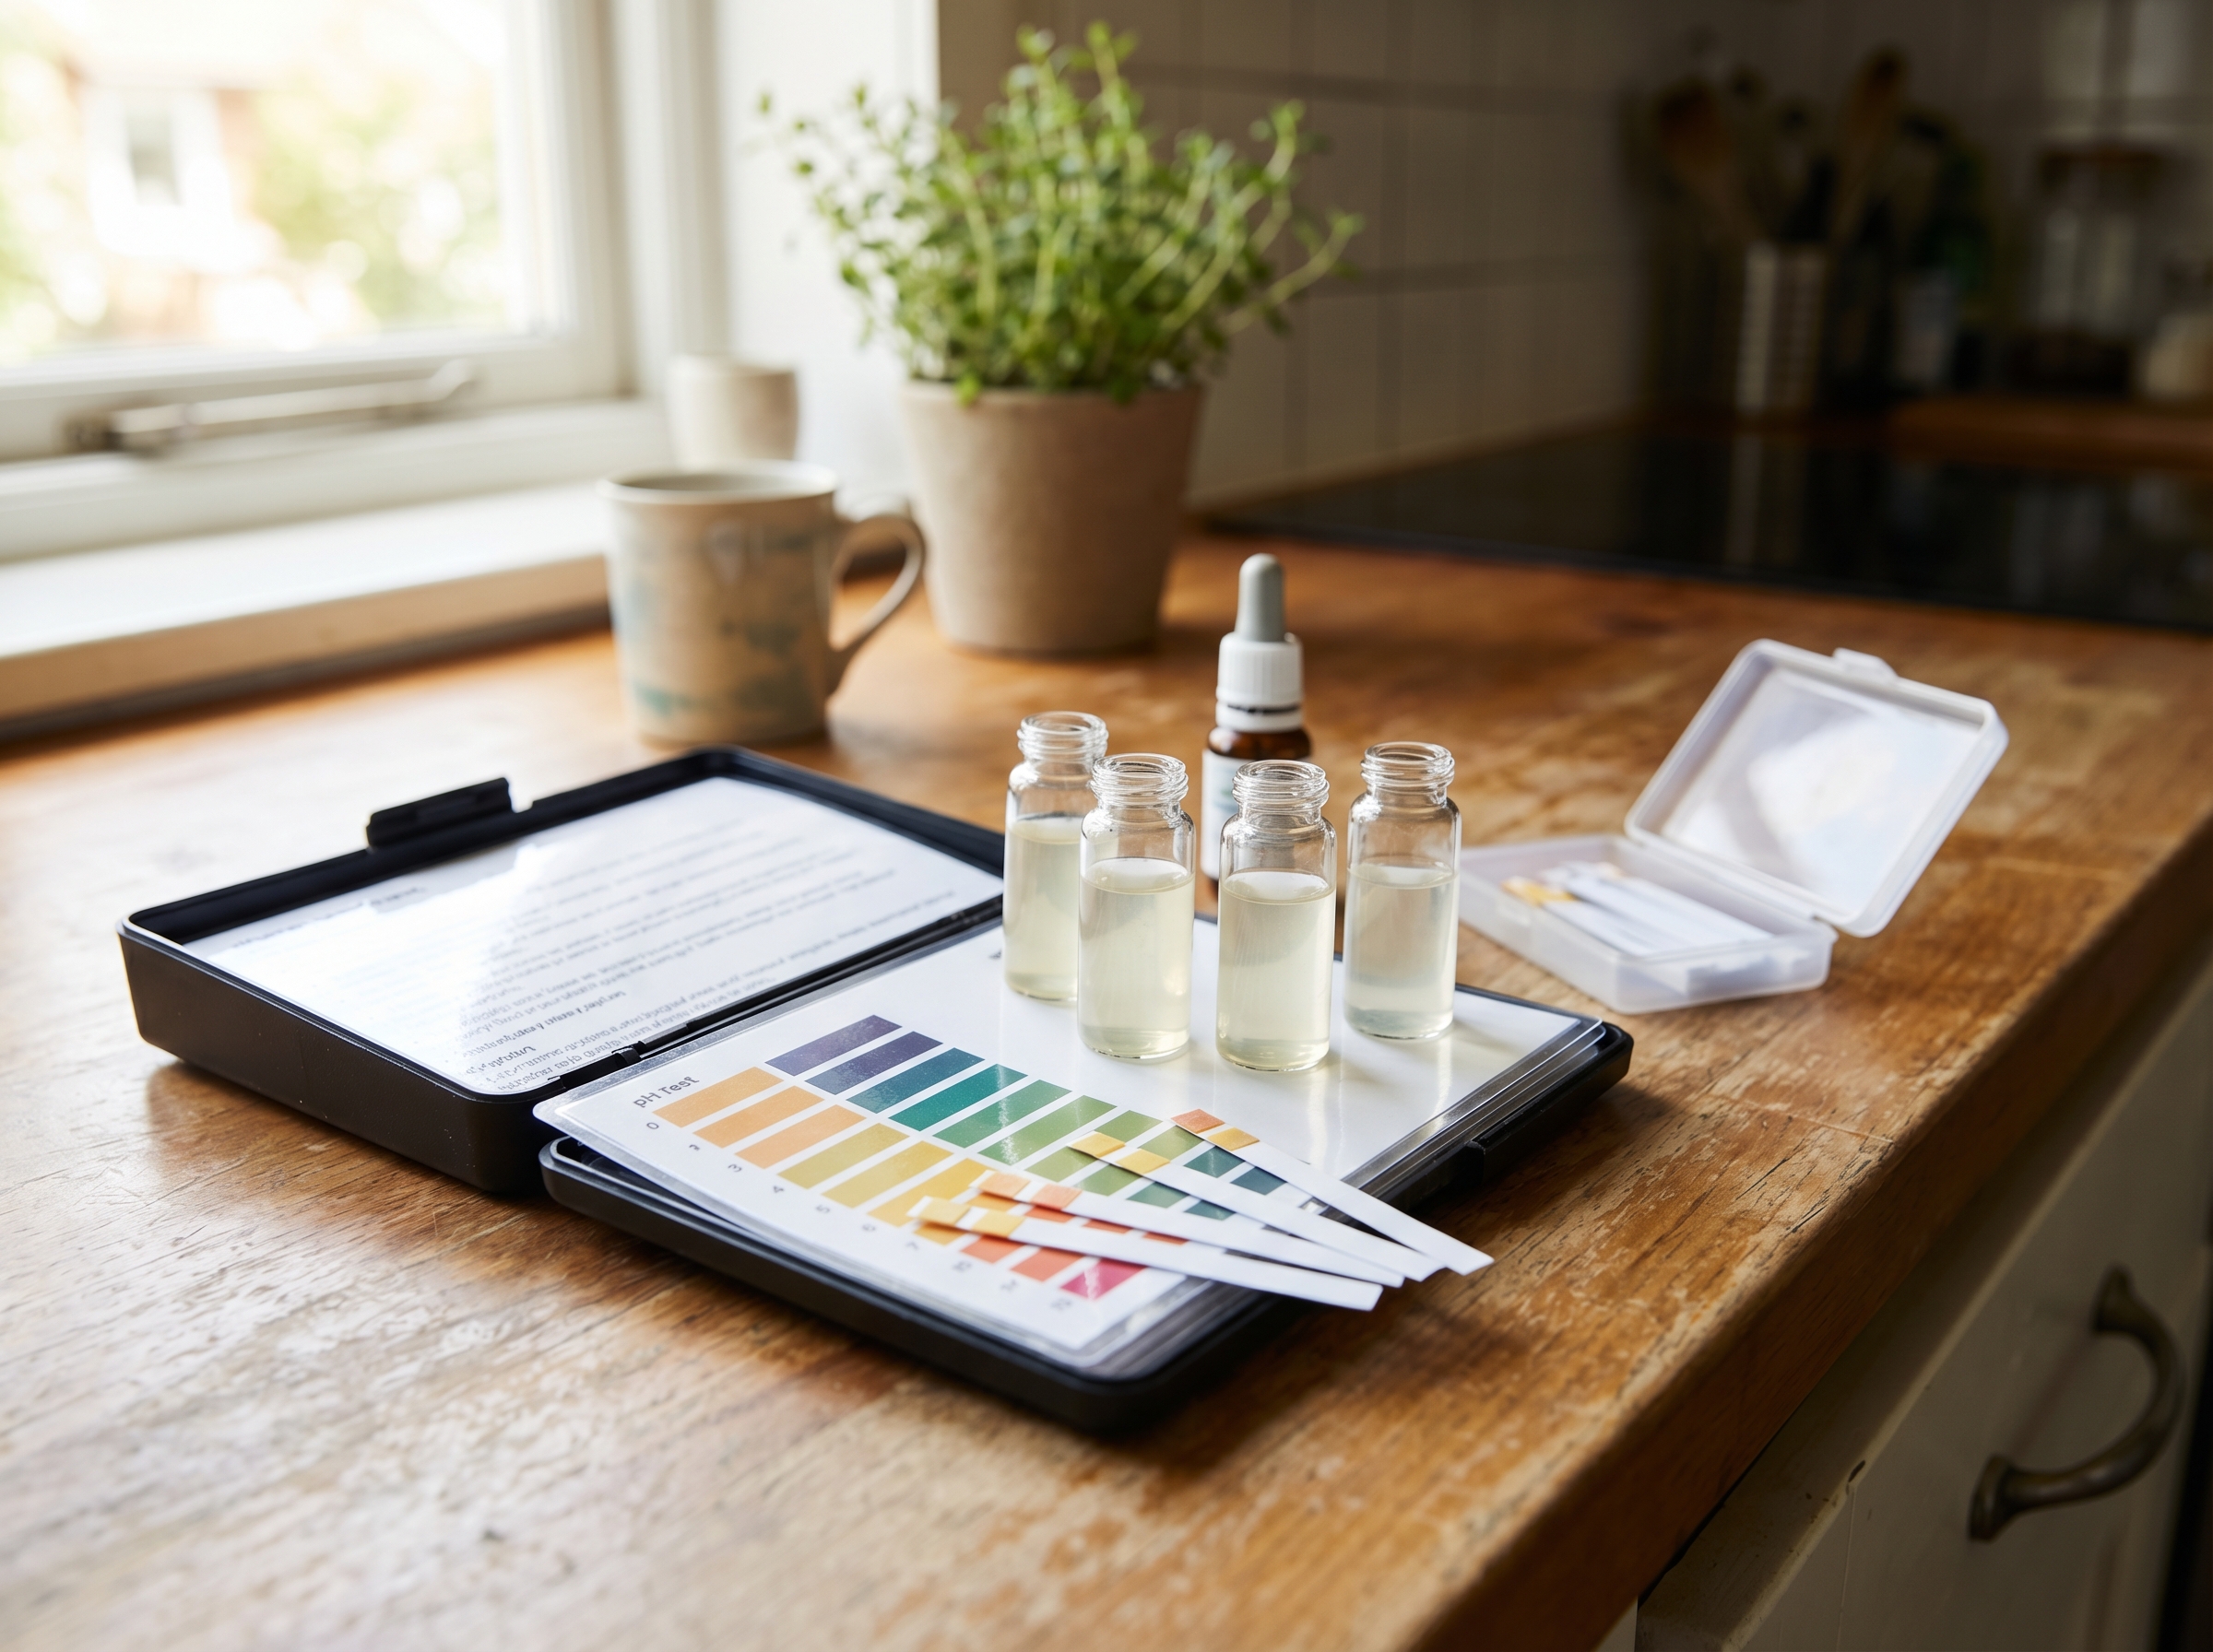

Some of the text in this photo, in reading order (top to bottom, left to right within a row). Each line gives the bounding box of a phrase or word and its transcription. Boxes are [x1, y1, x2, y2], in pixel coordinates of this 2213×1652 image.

[633, 1092, 662, 1108] pH
[645, 1122, 659, 1130] 0
[728, 1163, 742, 1173] 3
